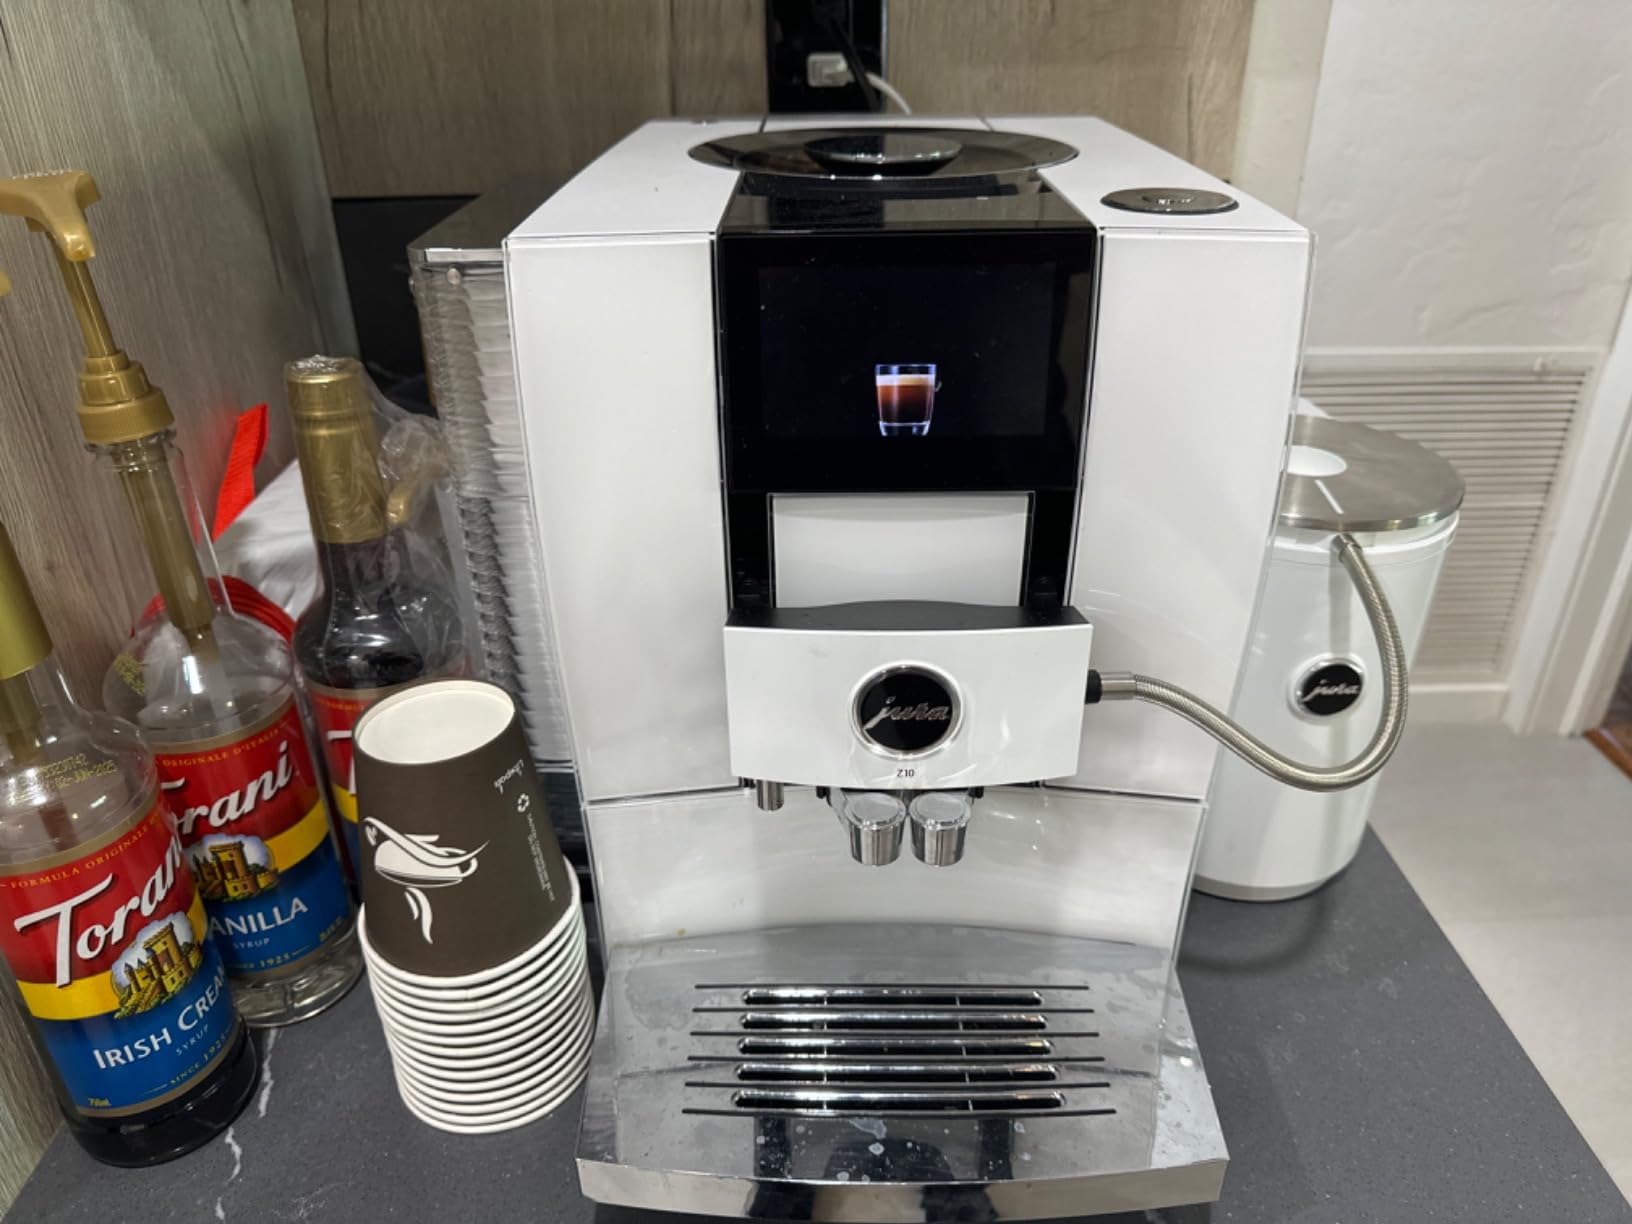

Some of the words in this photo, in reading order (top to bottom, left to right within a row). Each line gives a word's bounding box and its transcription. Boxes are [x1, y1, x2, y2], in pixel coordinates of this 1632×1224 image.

[863, 696, 949, 730] jura
[162, 751, 229, 767] ORIGINALE
[896, 768, 915, 778] Z10
[161, 740, 292, 834] rani
[10, 867, 81, 889] FORMULA
[14, 836, 182, 988] Toran
[207, 897, 309, 936] ANILLA
[233, 937, 270, 950] SYRUP
[92, 1027, 172, 1069] IRISH
[177, 962, 225, 1031] CREA
[175, 1024, 209, 1056] SYRUP
